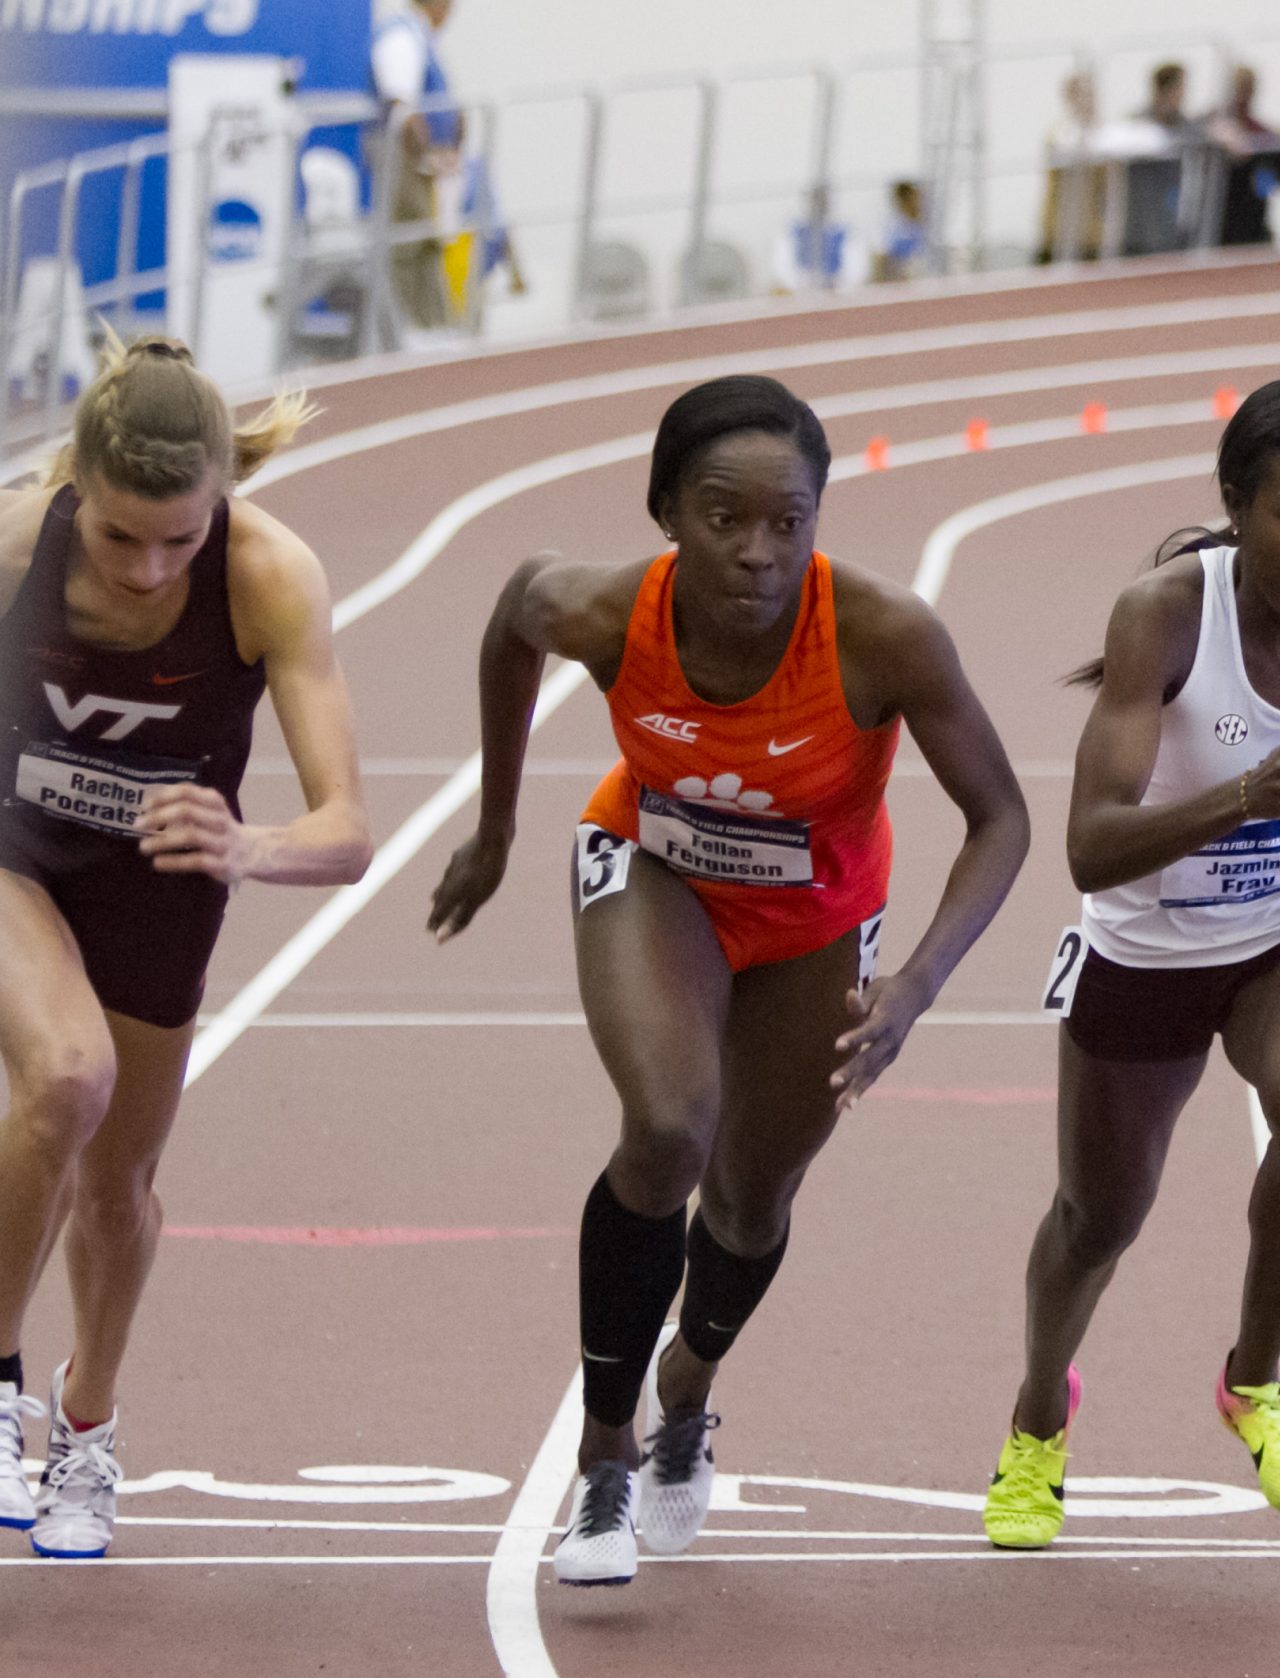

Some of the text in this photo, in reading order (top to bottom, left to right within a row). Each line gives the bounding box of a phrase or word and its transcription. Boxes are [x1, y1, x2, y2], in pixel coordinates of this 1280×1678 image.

[42, 681, 183, 741] VT
[638, 713, 702, 741] ACC
[1215, 714, 1248, 745] SEC
[39, 786, 146, 826] Pocrats
[70, 772, 144, 806] Rachel
[691, 833, 753, 859] Fellan
[725, 825, 806, 844] CHAMPIONSHIPS
[1230, 840, 1256, 851] FIELD
[582, 829, 628, 898] 3
[665, 839, 784, 877] Ferguson
[1044, 931, 1082, 1010] 2
